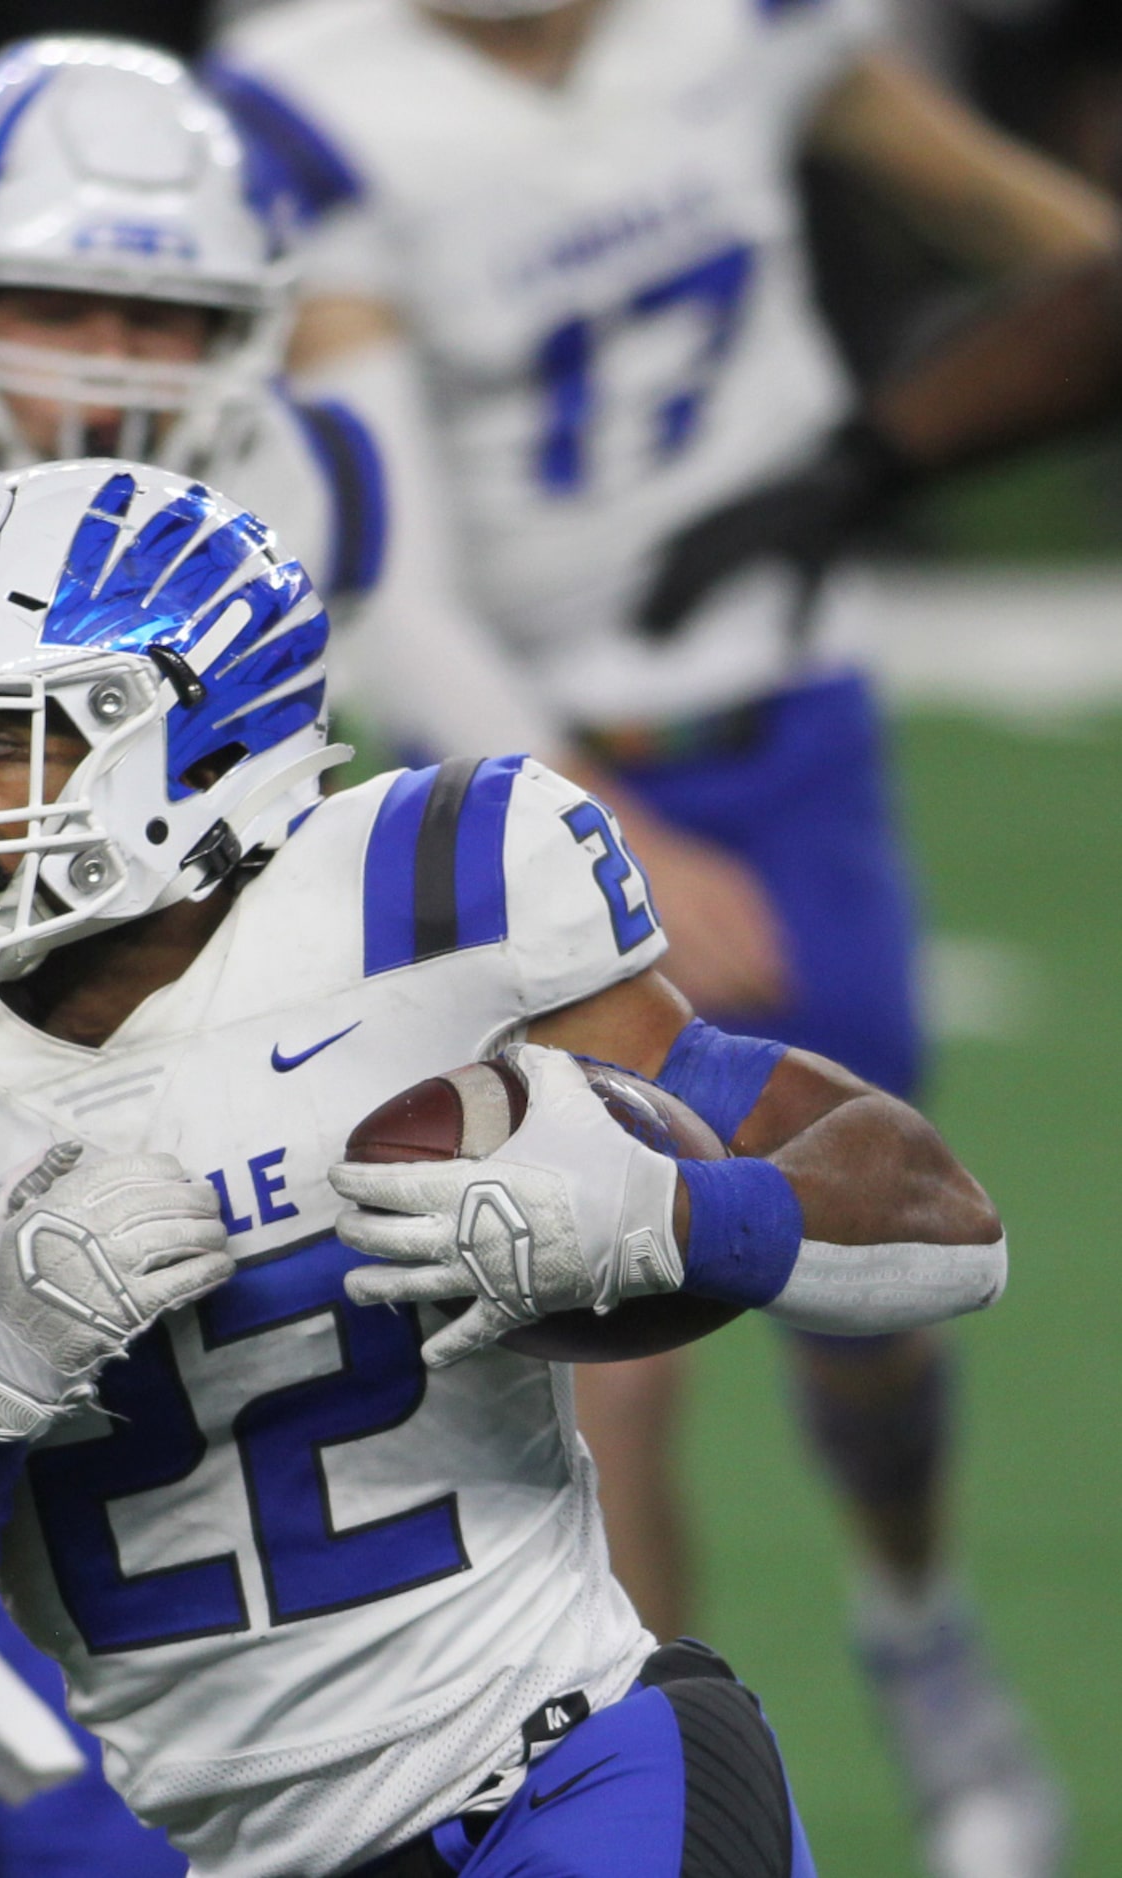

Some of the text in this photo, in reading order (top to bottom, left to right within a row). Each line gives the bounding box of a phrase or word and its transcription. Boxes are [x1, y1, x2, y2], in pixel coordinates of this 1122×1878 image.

[528, 238, 758, 502] 17
[560, 793, 662, 957] 2
[28, 1227, 472, 1656] 22
